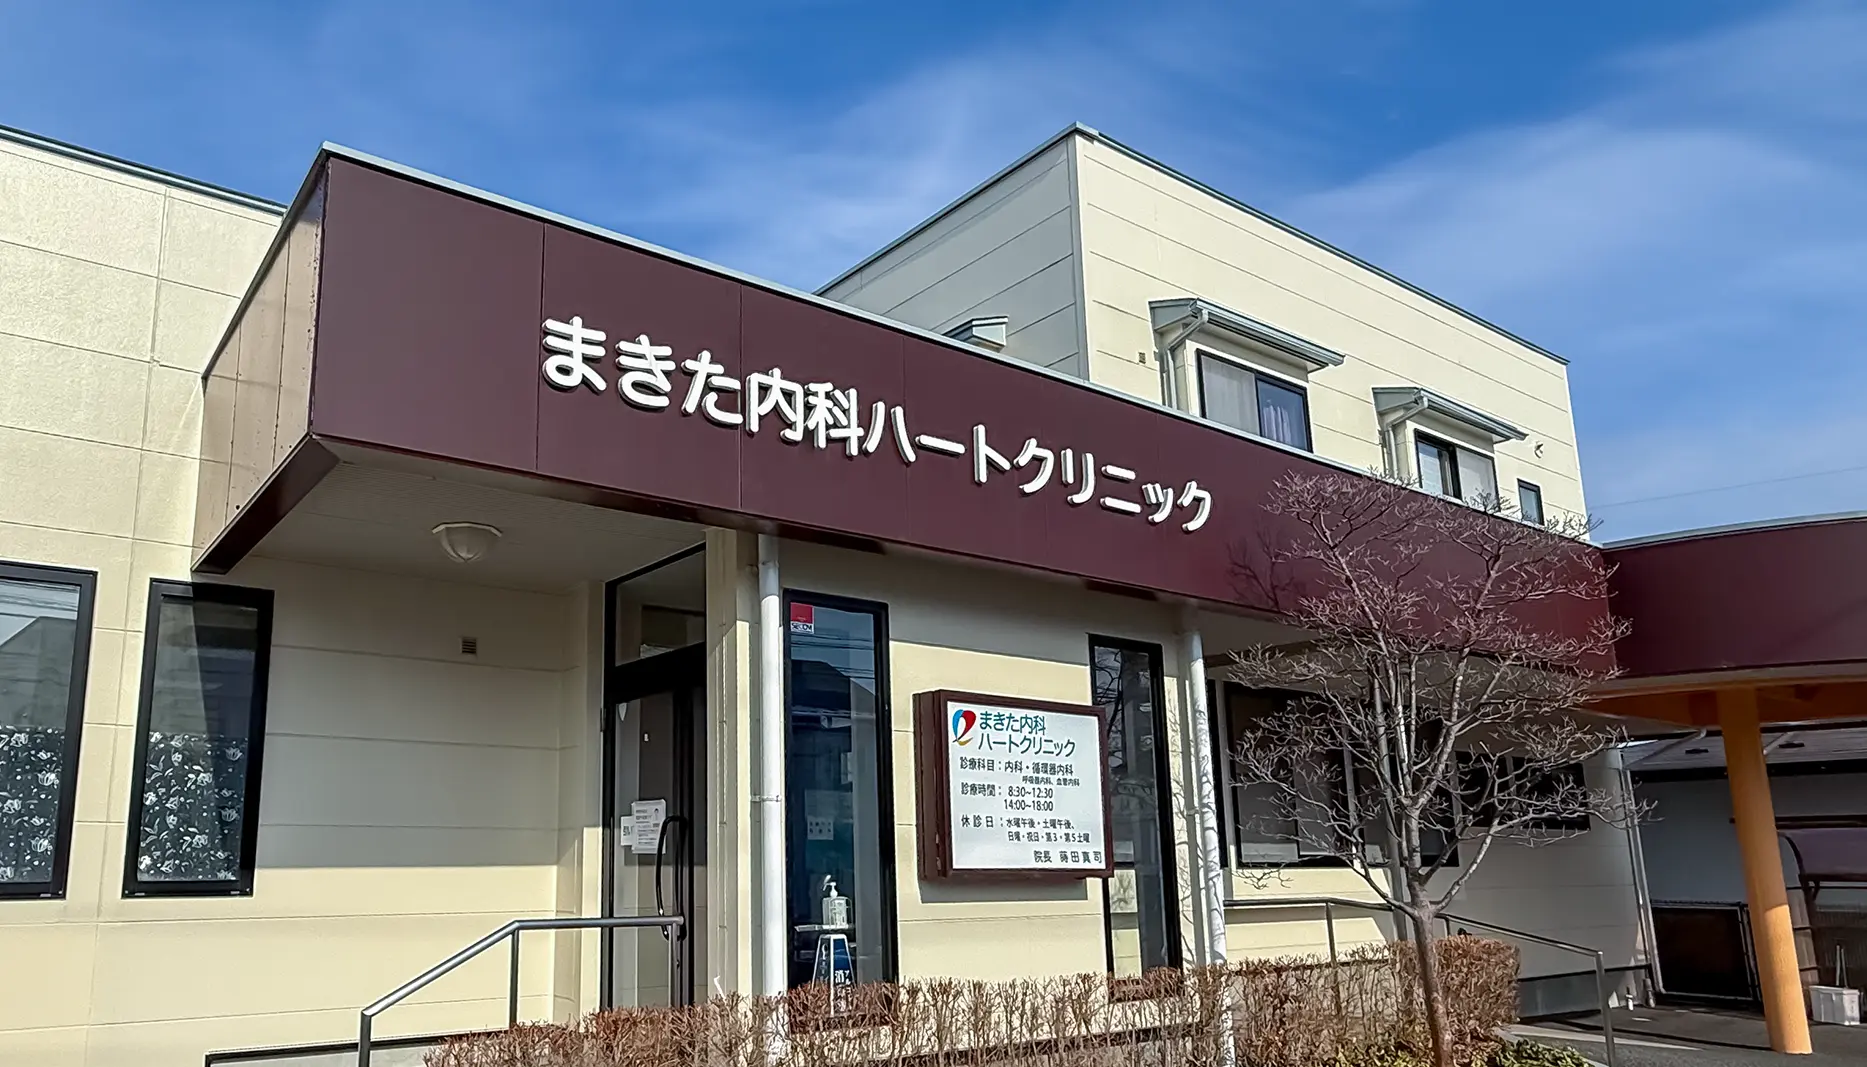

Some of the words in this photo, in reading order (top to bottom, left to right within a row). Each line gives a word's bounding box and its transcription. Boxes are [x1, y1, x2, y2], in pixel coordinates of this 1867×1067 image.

[541, 316, 1212, 533] まきた内科ハートクリニック
[979, 711, 1046, 735] まきた内科
[978, 733, 1076, 757] ハートクリニック
